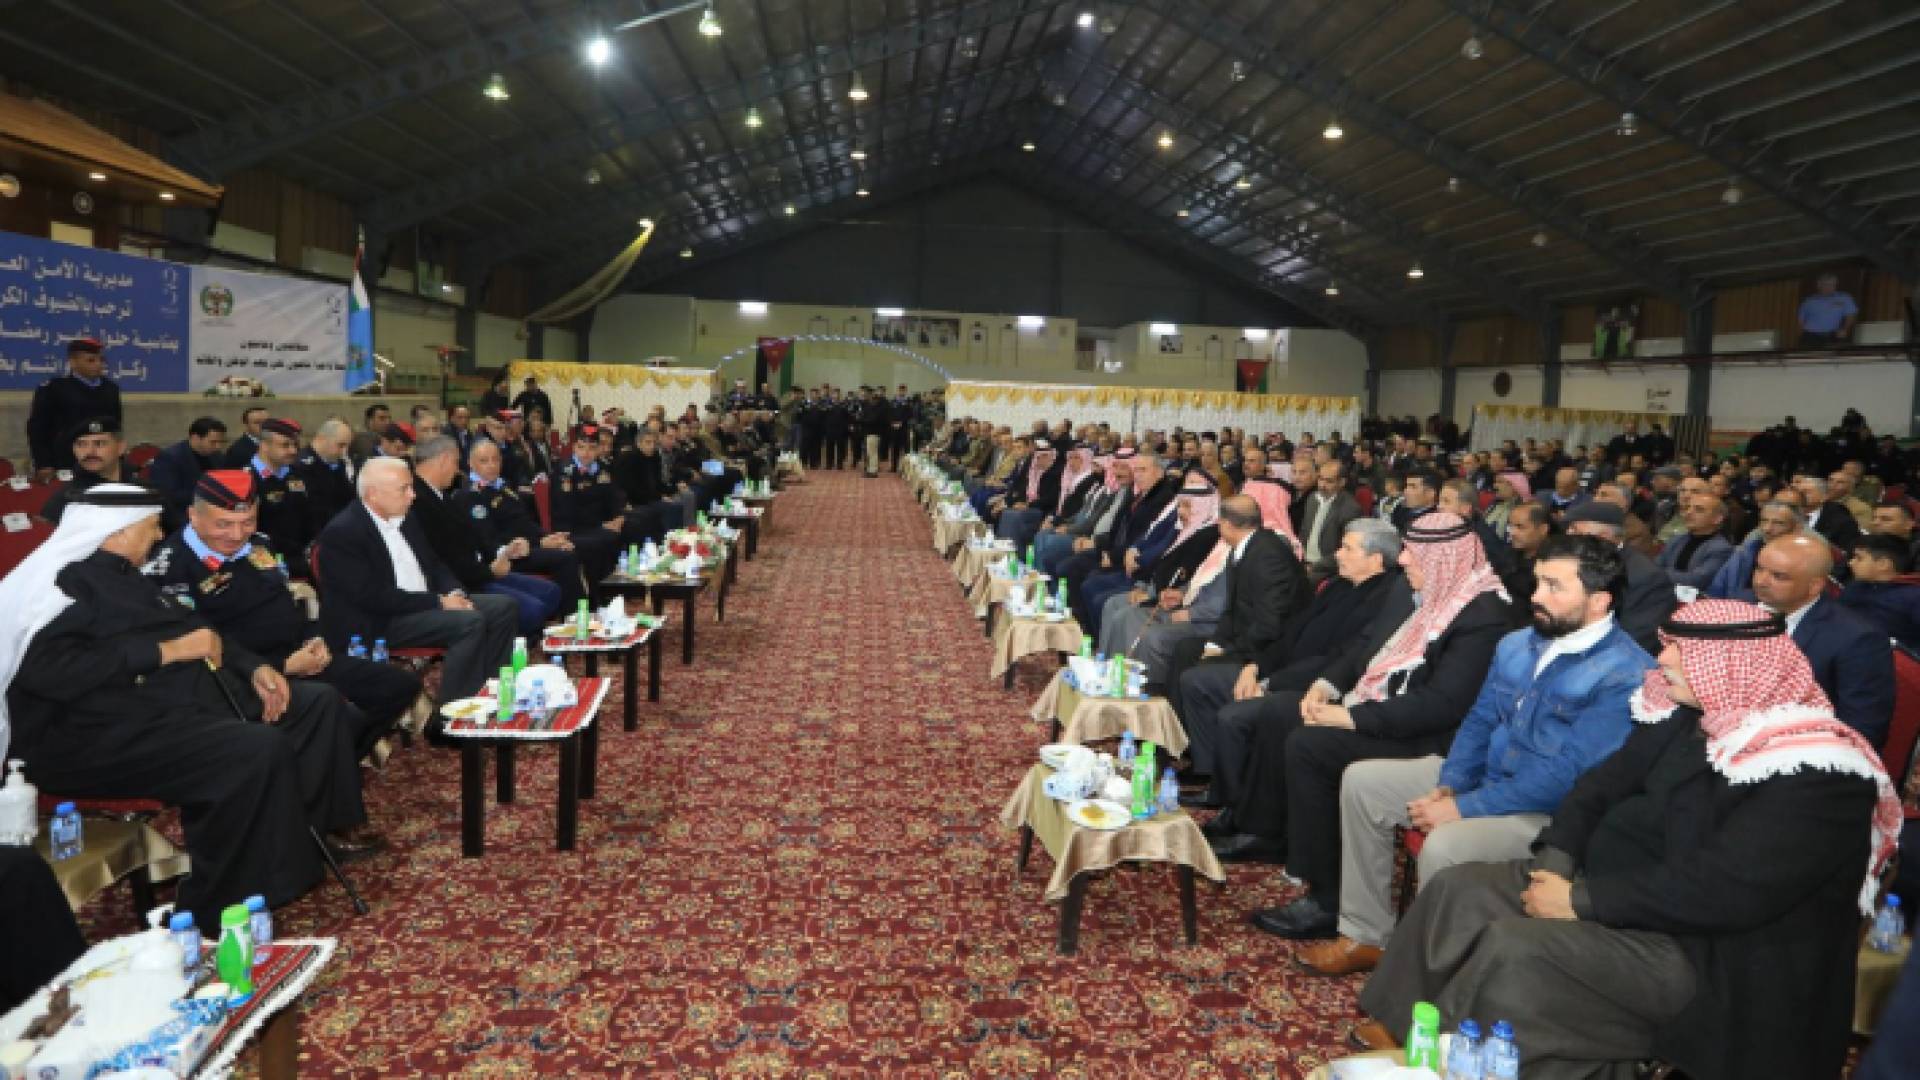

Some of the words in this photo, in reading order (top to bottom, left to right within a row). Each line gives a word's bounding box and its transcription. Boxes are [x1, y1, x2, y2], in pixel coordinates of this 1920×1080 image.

[83, 263, 133, 290] مديرية
[33, 286, 92, 316] بالضيوف
[94, 299, 132, 320] ترحب
[0, 319, 50, 345] رمضا
[132, 329, 179, 352] بمناسبة
[113, 359, 147, 380] وكل
